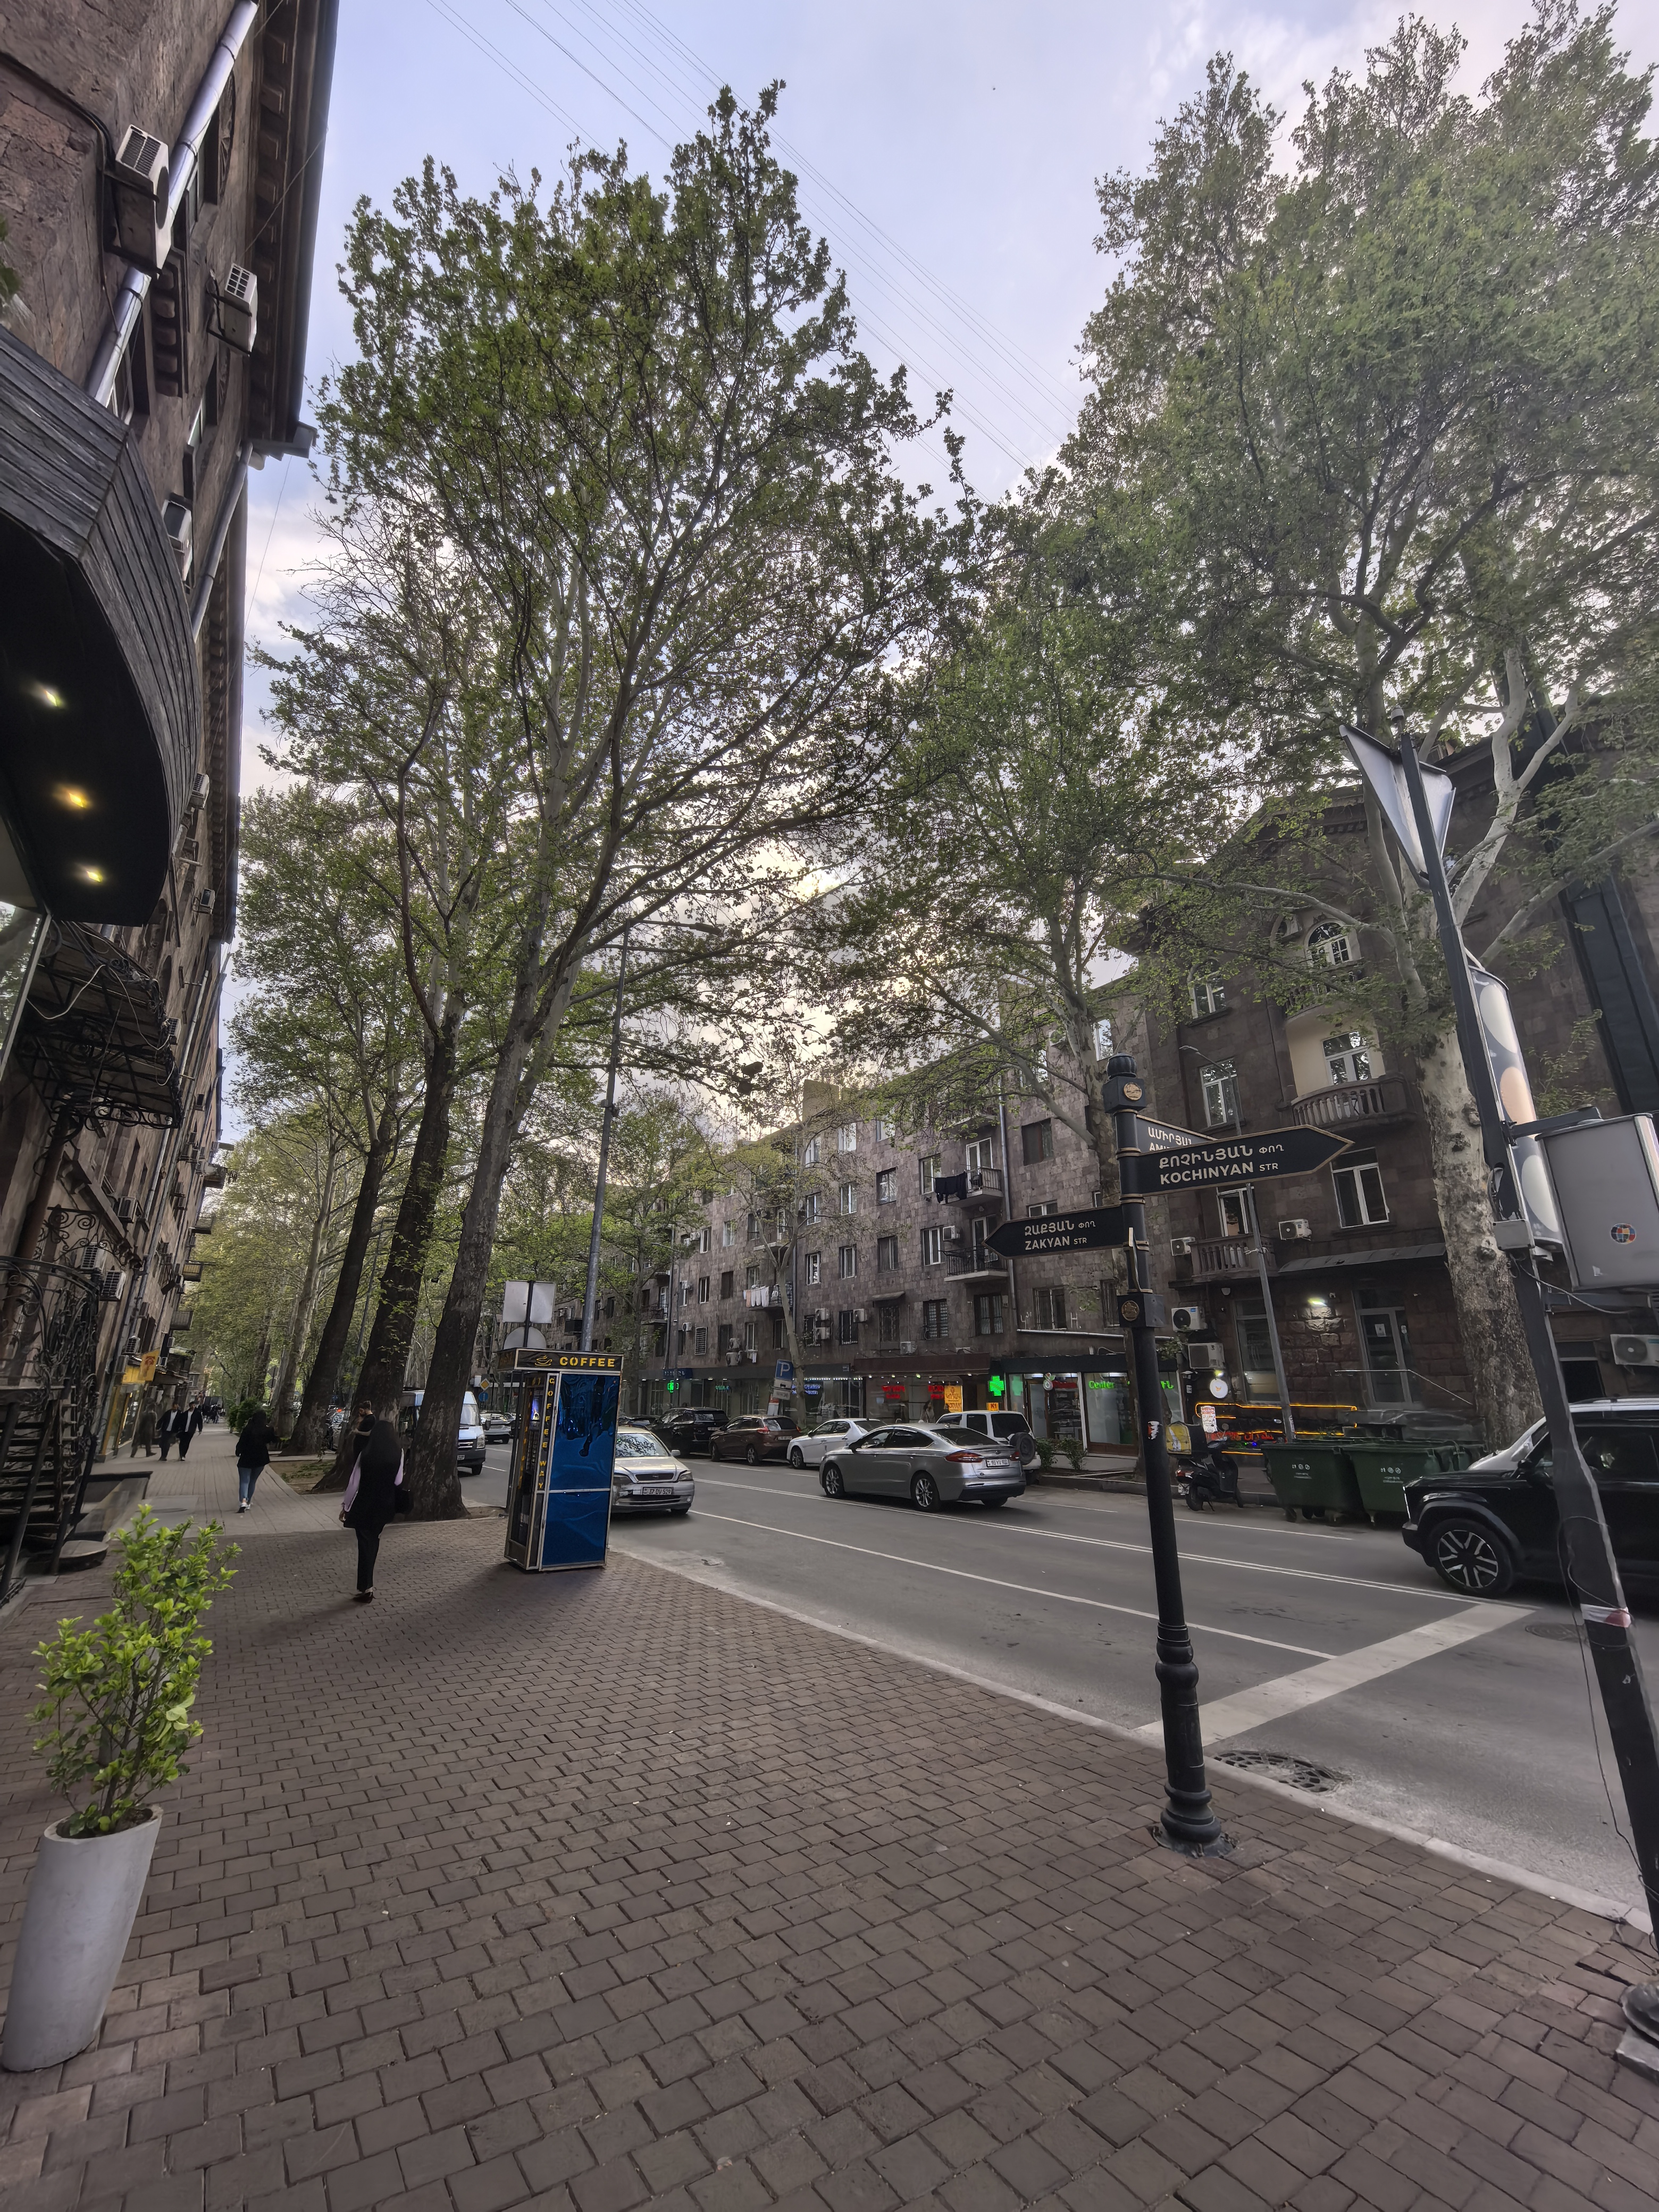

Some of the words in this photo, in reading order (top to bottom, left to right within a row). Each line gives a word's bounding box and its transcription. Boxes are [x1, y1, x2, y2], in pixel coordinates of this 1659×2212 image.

[1159, 1145, 1253, 1169] ՔՈՉԻՆՅԱՆ
[1259, 1144, 1285, 1154] ՓՈՂ
[1160, 1161, 1254, 1185] KOCHINYAN
[1259, 1162, 1279, 1171] STR
[1024, 1220, 1075, 1236] ԶԱՔՅԱՆ
[1078, 1220, 1096, 1229] ՓՈՂ
[1025, 1236, 1070, 1250] ZAKYAN
[559, 1356, 616, 1367] COFFEE
[780, 1362, 791, 1377] P
[542, 1378, 555, 1448] COFFEE
